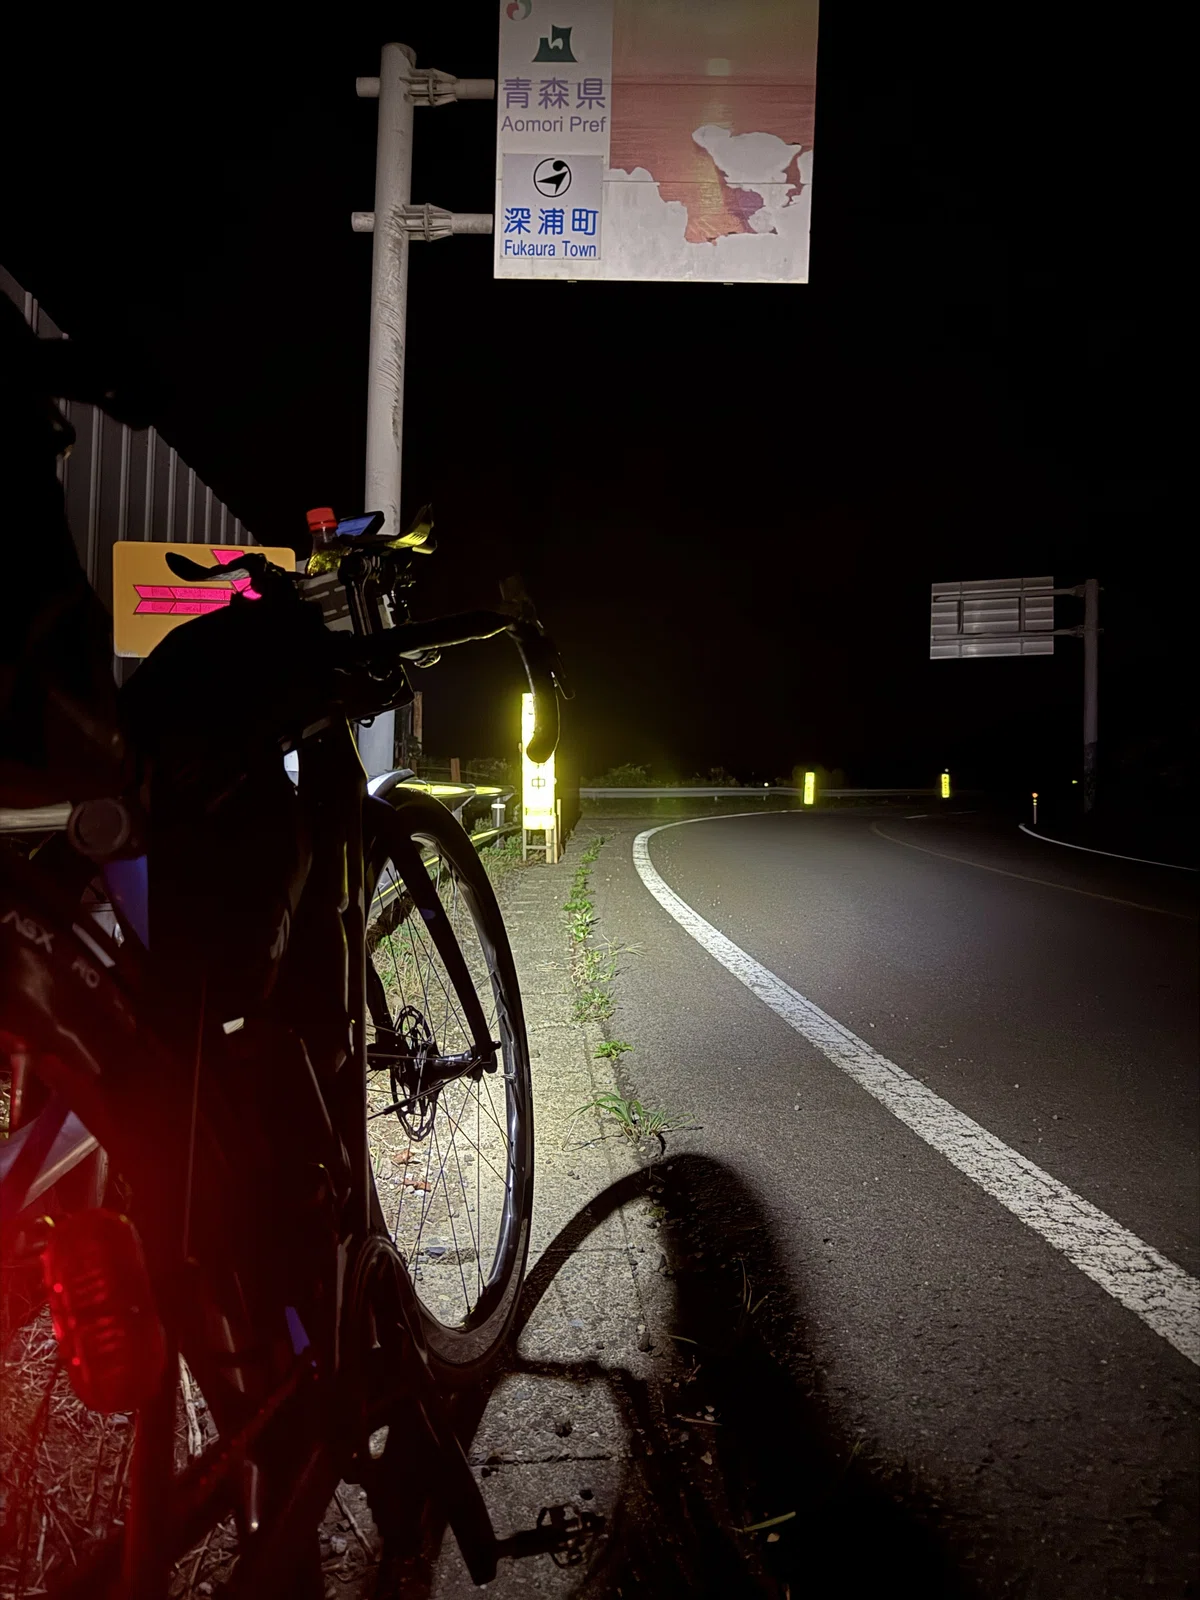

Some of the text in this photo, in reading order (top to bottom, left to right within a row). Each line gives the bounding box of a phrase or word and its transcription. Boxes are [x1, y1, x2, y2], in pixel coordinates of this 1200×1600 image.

[503, 77, 606, 110] 青森県
[501, 115, 607, 133] Aomori Pref
[504, 207, 599, 236] 深浦町
[504, 239, 597, 257] Fukaura Town
